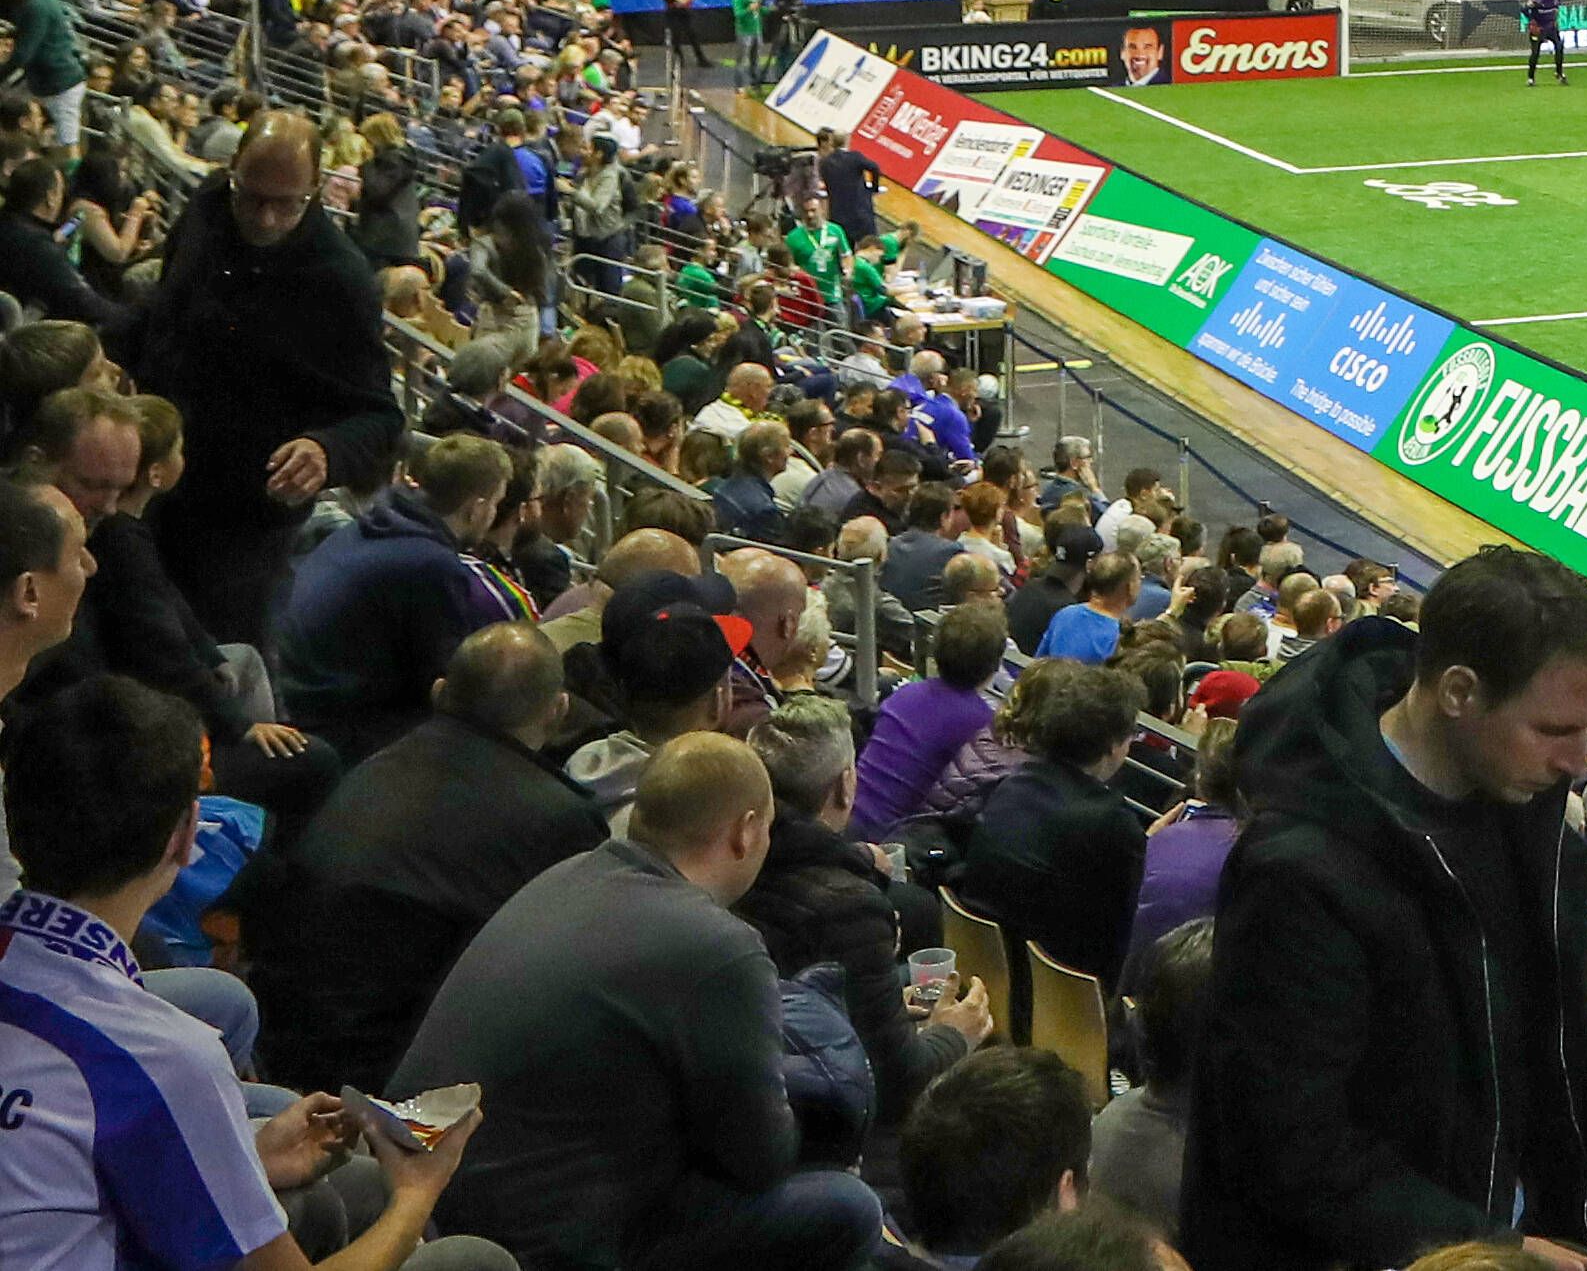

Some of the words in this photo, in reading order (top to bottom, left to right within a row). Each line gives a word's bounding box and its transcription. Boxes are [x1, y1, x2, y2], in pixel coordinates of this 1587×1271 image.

[921, 42, 1107, 71] BKING24.com
[1180, 27, 1330, 75] Emons
[1175, 252, 1234, 299] AOK
[1329, 346, 1390, 393] CISCO
